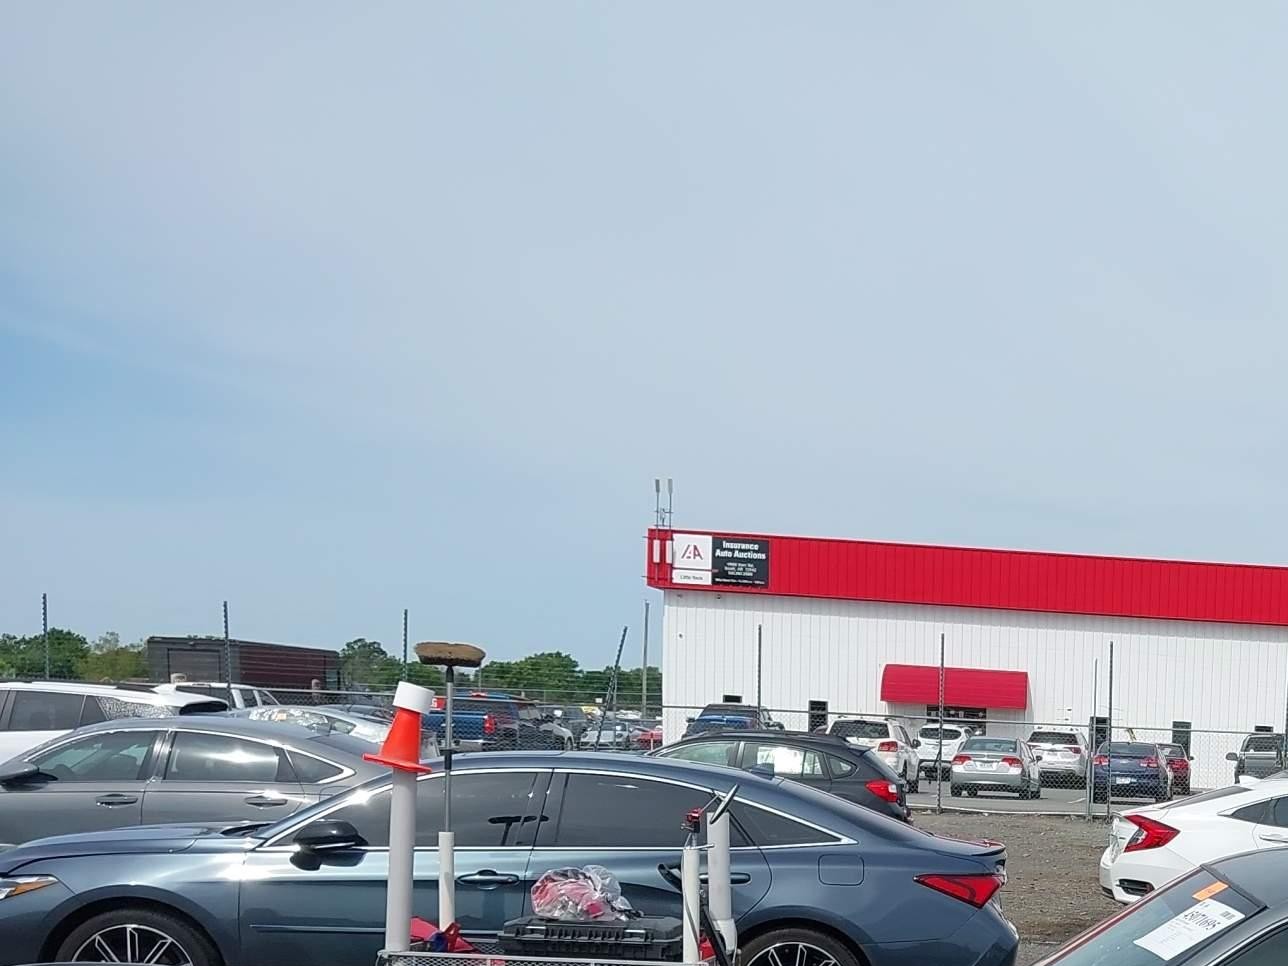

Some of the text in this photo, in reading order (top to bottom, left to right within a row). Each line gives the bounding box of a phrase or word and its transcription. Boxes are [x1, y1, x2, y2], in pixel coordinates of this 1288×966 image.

[722, 540, 759, 550] Insurance
[715, 549, 766, 560] Auto Auctions
